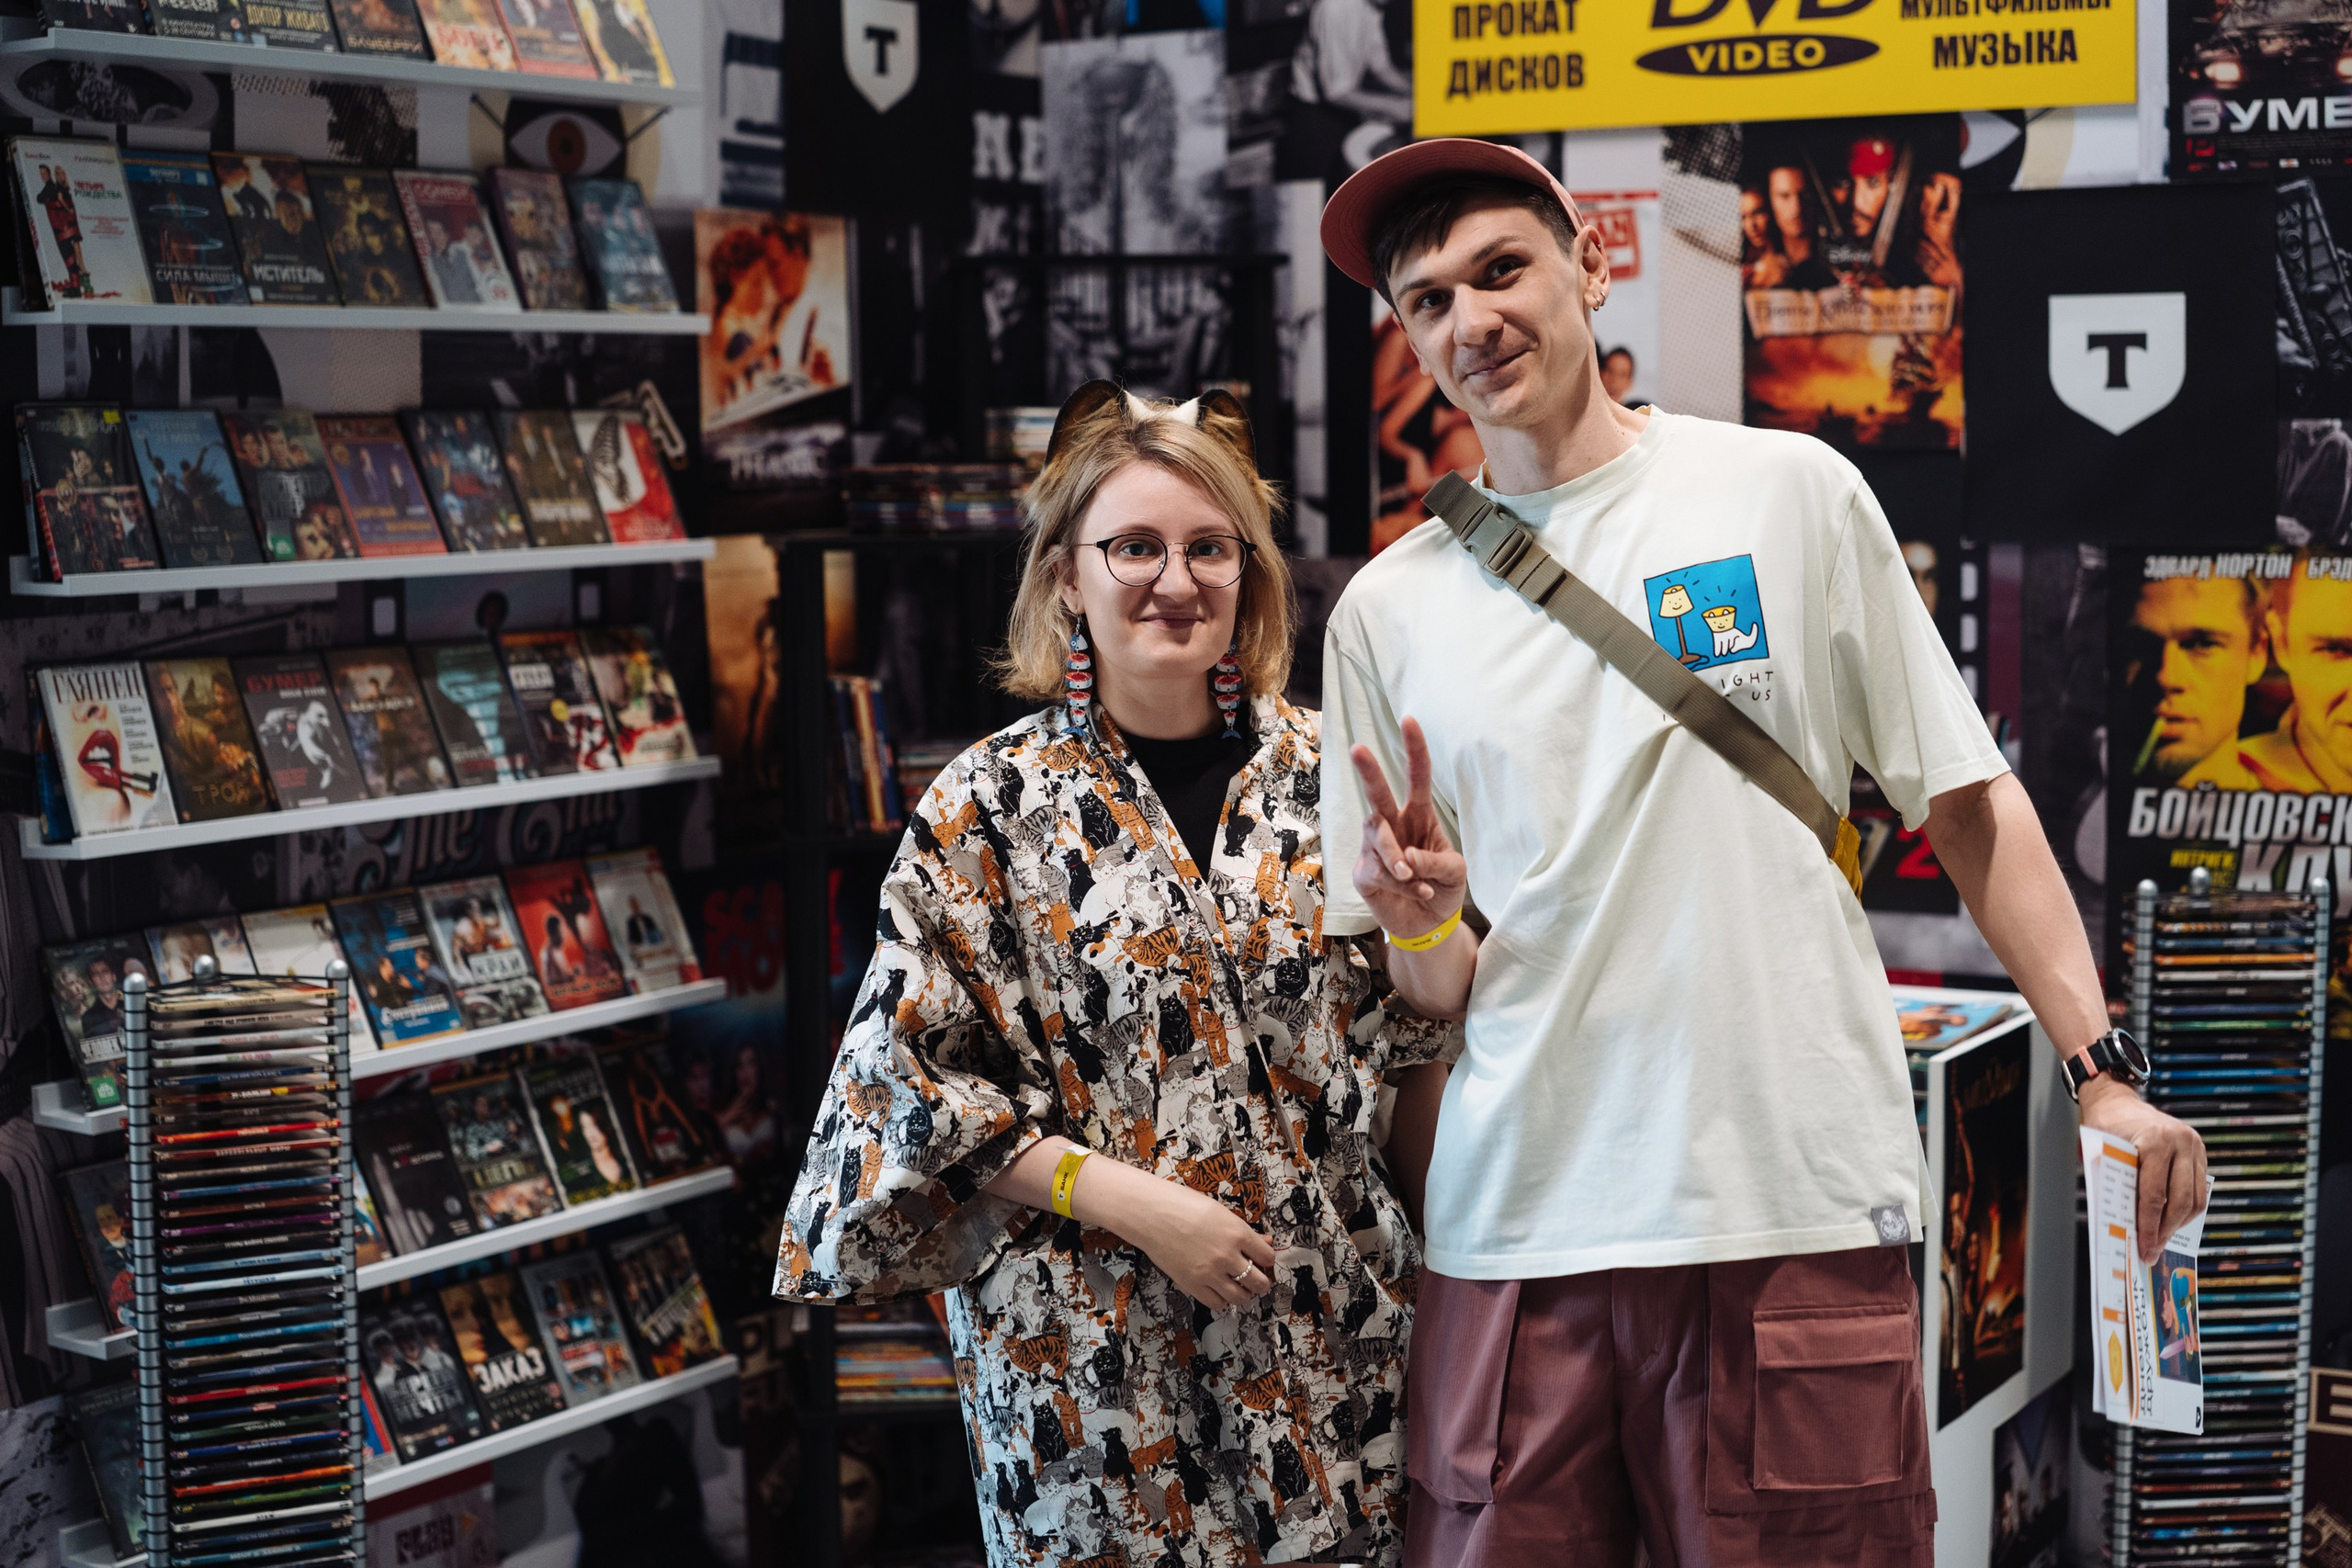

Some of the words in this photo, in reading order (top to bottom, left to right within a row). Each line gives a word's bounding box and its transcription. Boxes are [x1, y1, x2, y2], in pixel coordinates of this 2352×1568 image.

[1453, 0, 1578, 39] ПРОКАТ
[1687, 39, 1826, 73] VIDEO
[1932, 29, 2078, 69] МУЗЫКА
[1447, 53, 1585, 101] ДИСКОВ
[2143, 555, 2211, 581] ЭДВАРД
[2215, 553, 2293, 579] НОРТОН
[2306, 557, 2352, 581] БРЭД
[52, 670, 143, 704] ГЛЯНЕЦ
[246, 671, 322, 693] БУМЕР
[1721, 671, 1774, 689] IGHT
[192, 781, 250, 806] ТРОЯ
[2128, 781, 2352, 849] БОЙЦОВСК
[473, 1347, 547, 1394] ЗАКАЗ
